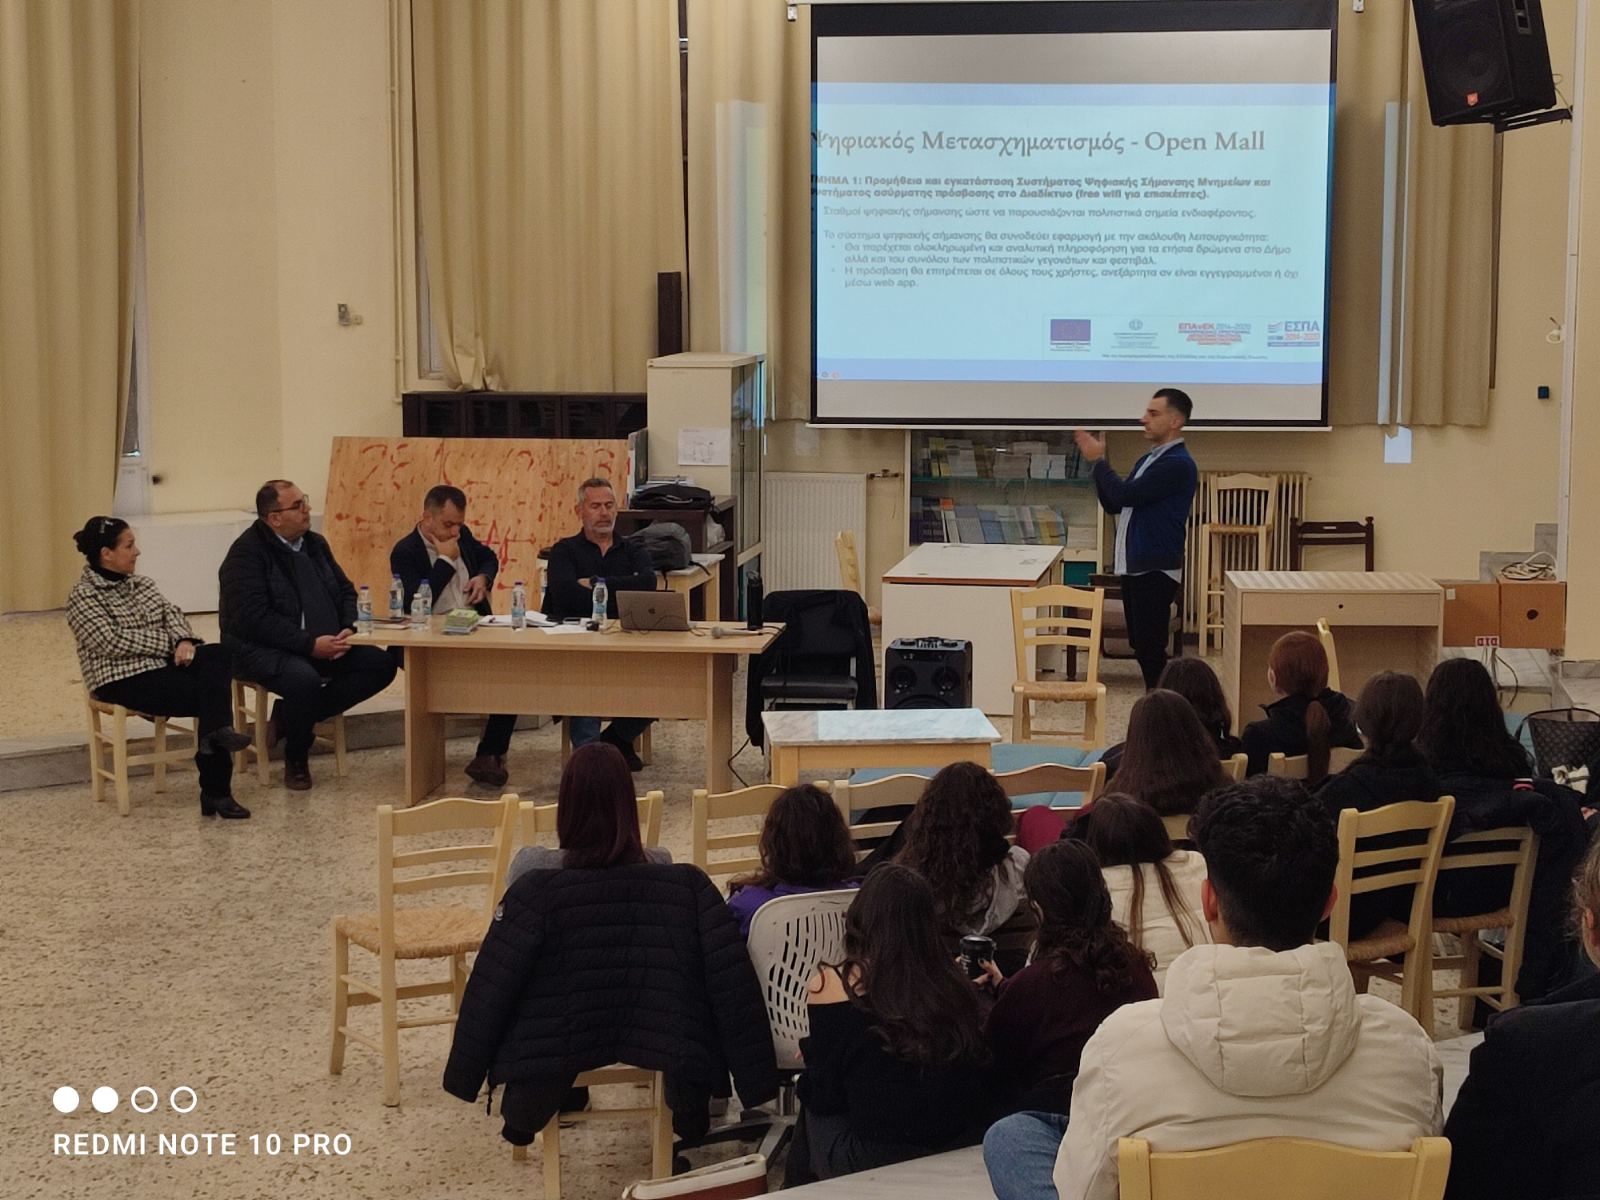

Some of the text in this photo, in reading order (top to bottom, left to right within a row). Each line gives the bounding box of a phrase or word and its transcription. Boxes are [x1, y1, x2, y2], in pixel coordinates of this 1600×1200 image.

[921, 131, 1125, 157] Μετασχηματισμός
[1144, 131, 1207, 156] Open
[1214, 131, 1265, 151] Mall
[865, 174, 923, 187] Προμήθεια
[925, 178, 942, 186] και
[944, 175, 1014, 188] εγκατάσταση
[1017, 176, 1082, 188] Συστήματος
[1084, 177, 1138, 188] Ψηφιακής
[1141, 177, 1195, 188] Σήμανσης
[1197, 177, 1252, 188] Μνημείων
[1254, 179, 1271, 187] και
[935, 188, 995, 200] πρόσβασης
[997, 190, 1017, 198] στο
[1019, 188, 1073, 199] Διαδίκτυο
[1124, 190, 1141, 200] για
[965, 206, 990, 217] ώστε
[1144, 208, 1179, 218] σημεία
[984, 231, 997, 240] θα
[1104, 233, 1116, 242] με
[1119, 233, 1136, 242] την
[1243, 246, 1262, 254] στο
[910, 266, 923, 275] θα
[873, 279, 895, 288] web
[1284, 320, 1320, 332] ΕΣΠΑ
